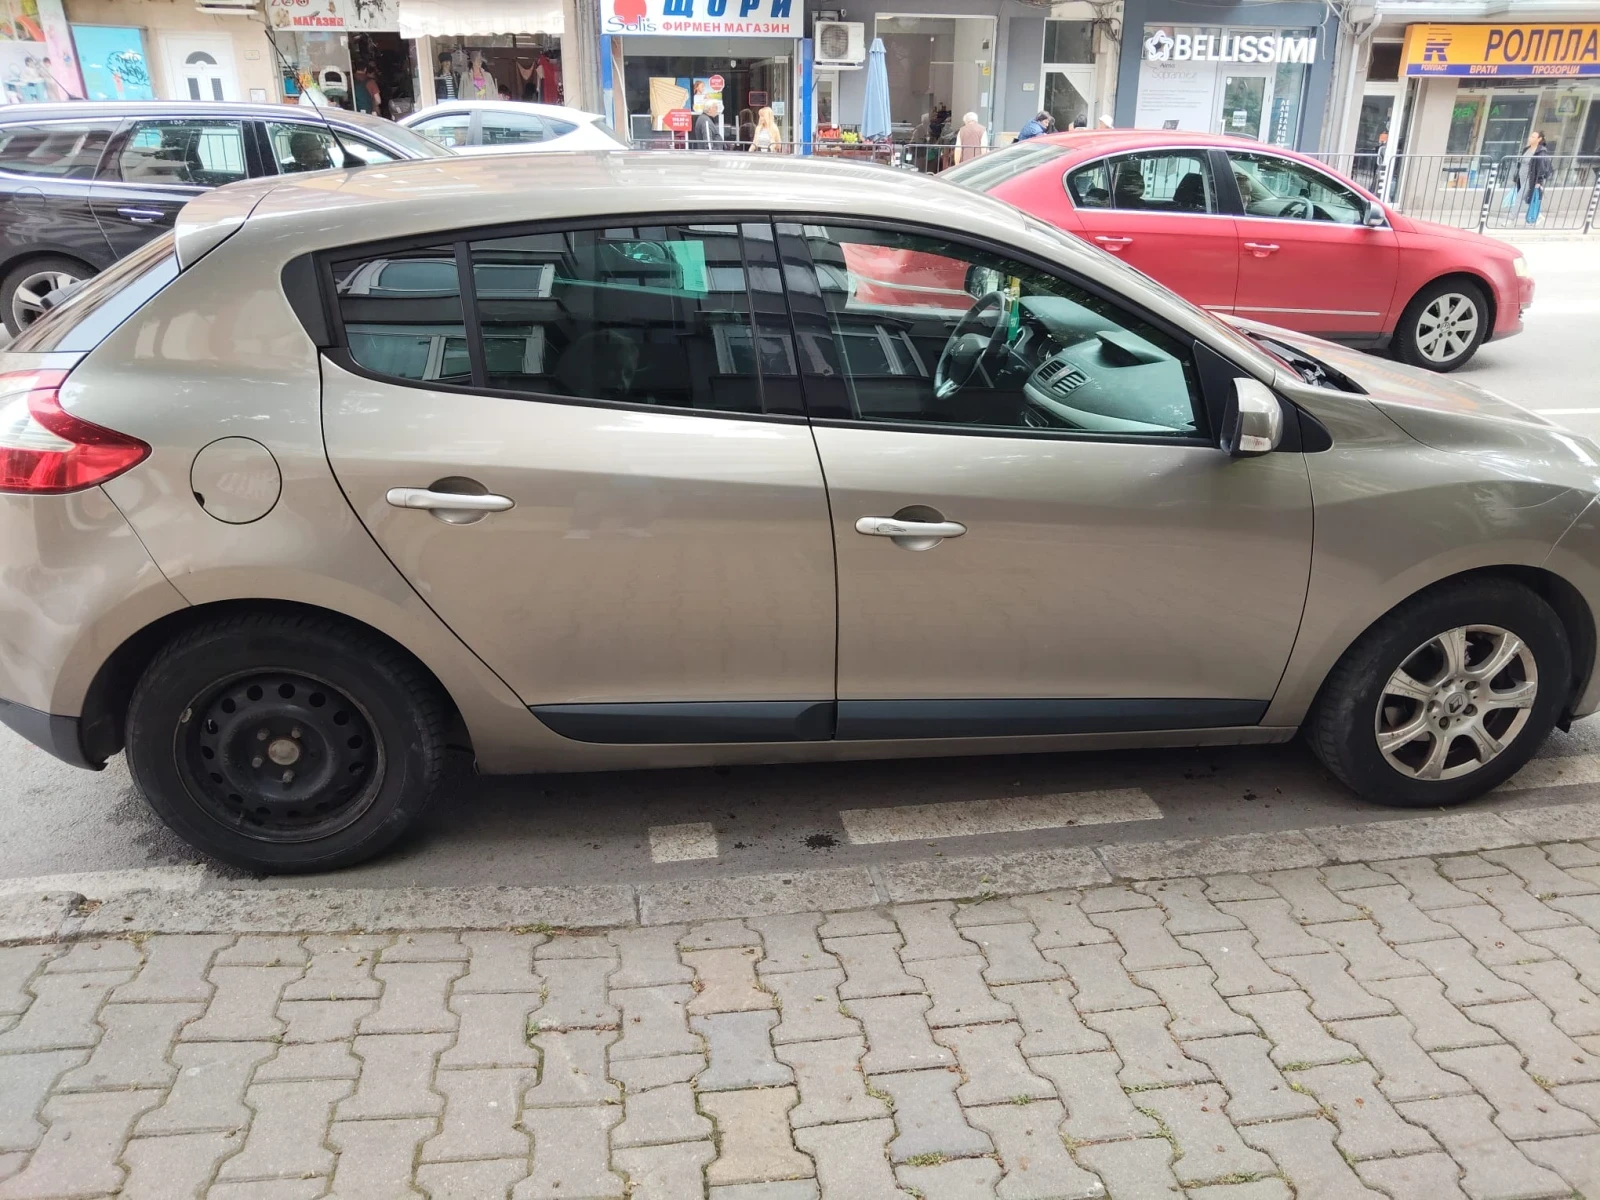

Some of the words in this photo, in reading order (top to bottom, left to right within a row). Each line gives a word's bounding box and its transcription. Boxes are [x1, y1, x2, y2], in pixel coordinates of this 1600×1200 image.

[292, 16, 344, 26] МАГАЗИН
[606, 16, 657, 33] Solis
[662, 22, 721, 33] ФИРМЕН
[724, 22, 790, 33] МАГАЗИН
[1173, 34, 1317, 64] BELLISSIMI
[1484, 29, 1598, 62] РОЛПЛА
[1469, 65, 1498, 74] ВРАТИ
[1531, 65, 1580, 75] ПРОЗОРЦИ
